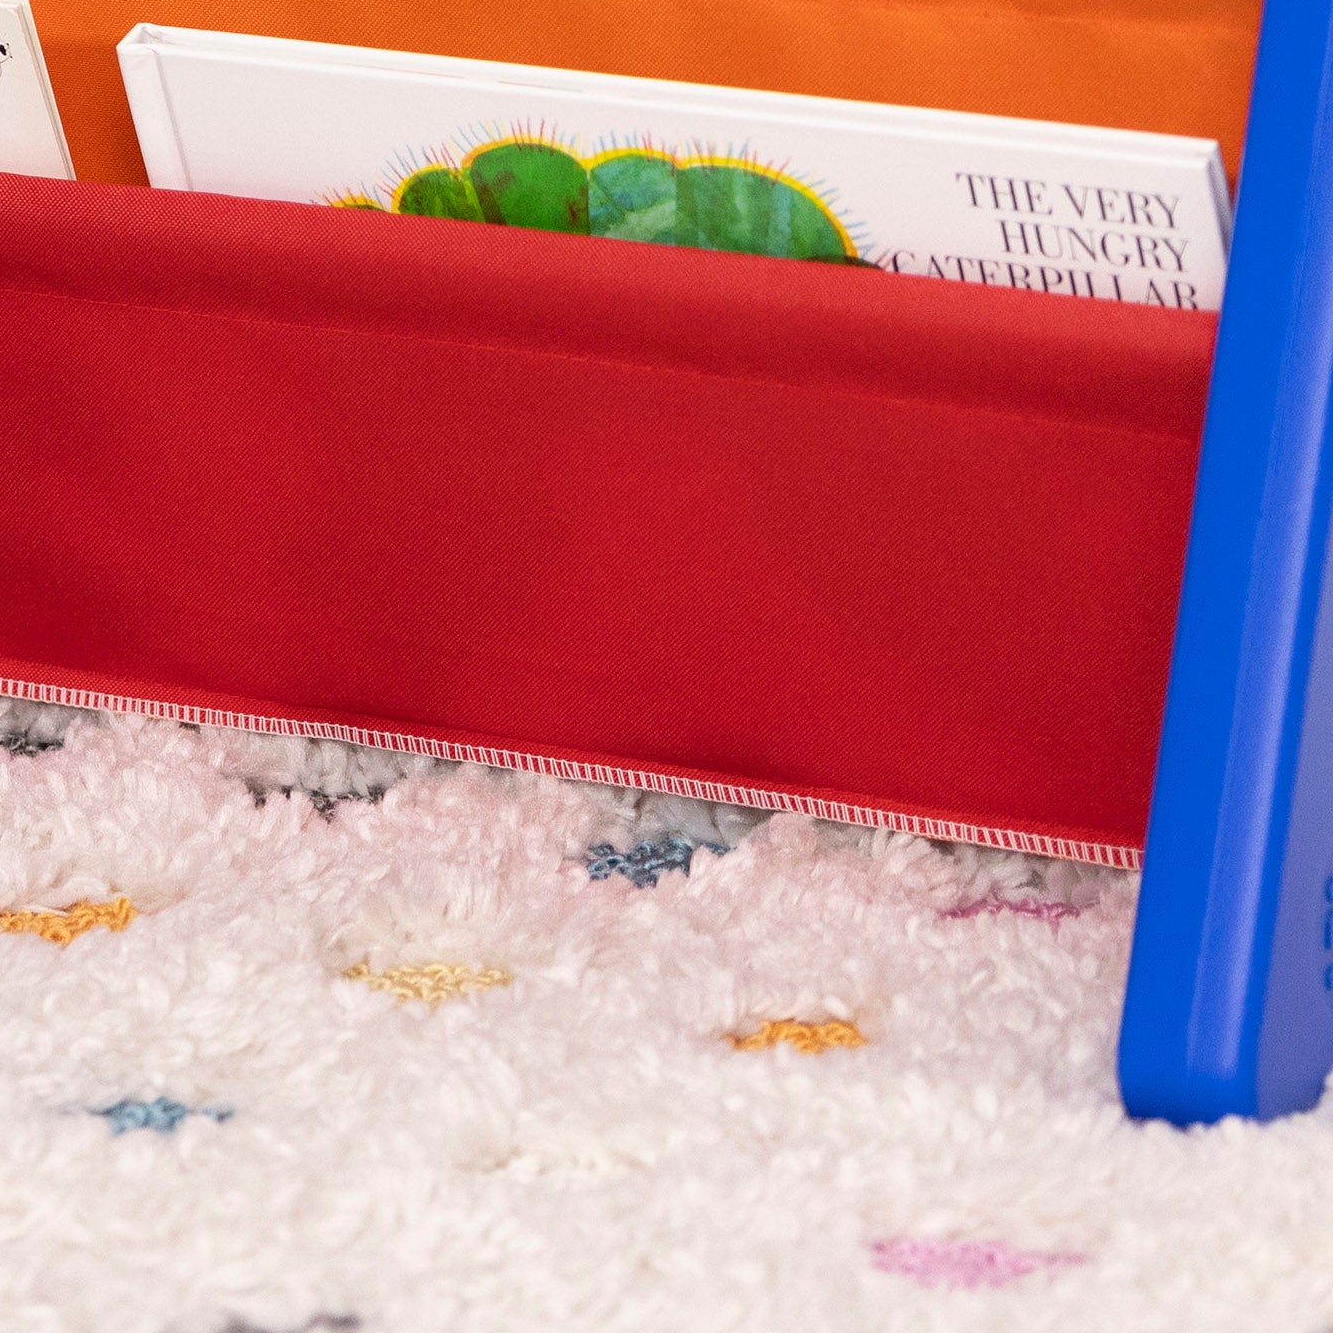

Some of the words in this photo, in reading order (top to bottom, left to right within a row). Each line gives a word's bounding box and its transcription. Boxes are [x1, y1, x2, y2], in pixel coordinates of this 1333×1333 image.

[954, 171, 1053, 217] THE
[1061, 182, 1182, 230] VERY
[998, 219, 1190, 274] HUNGRY
